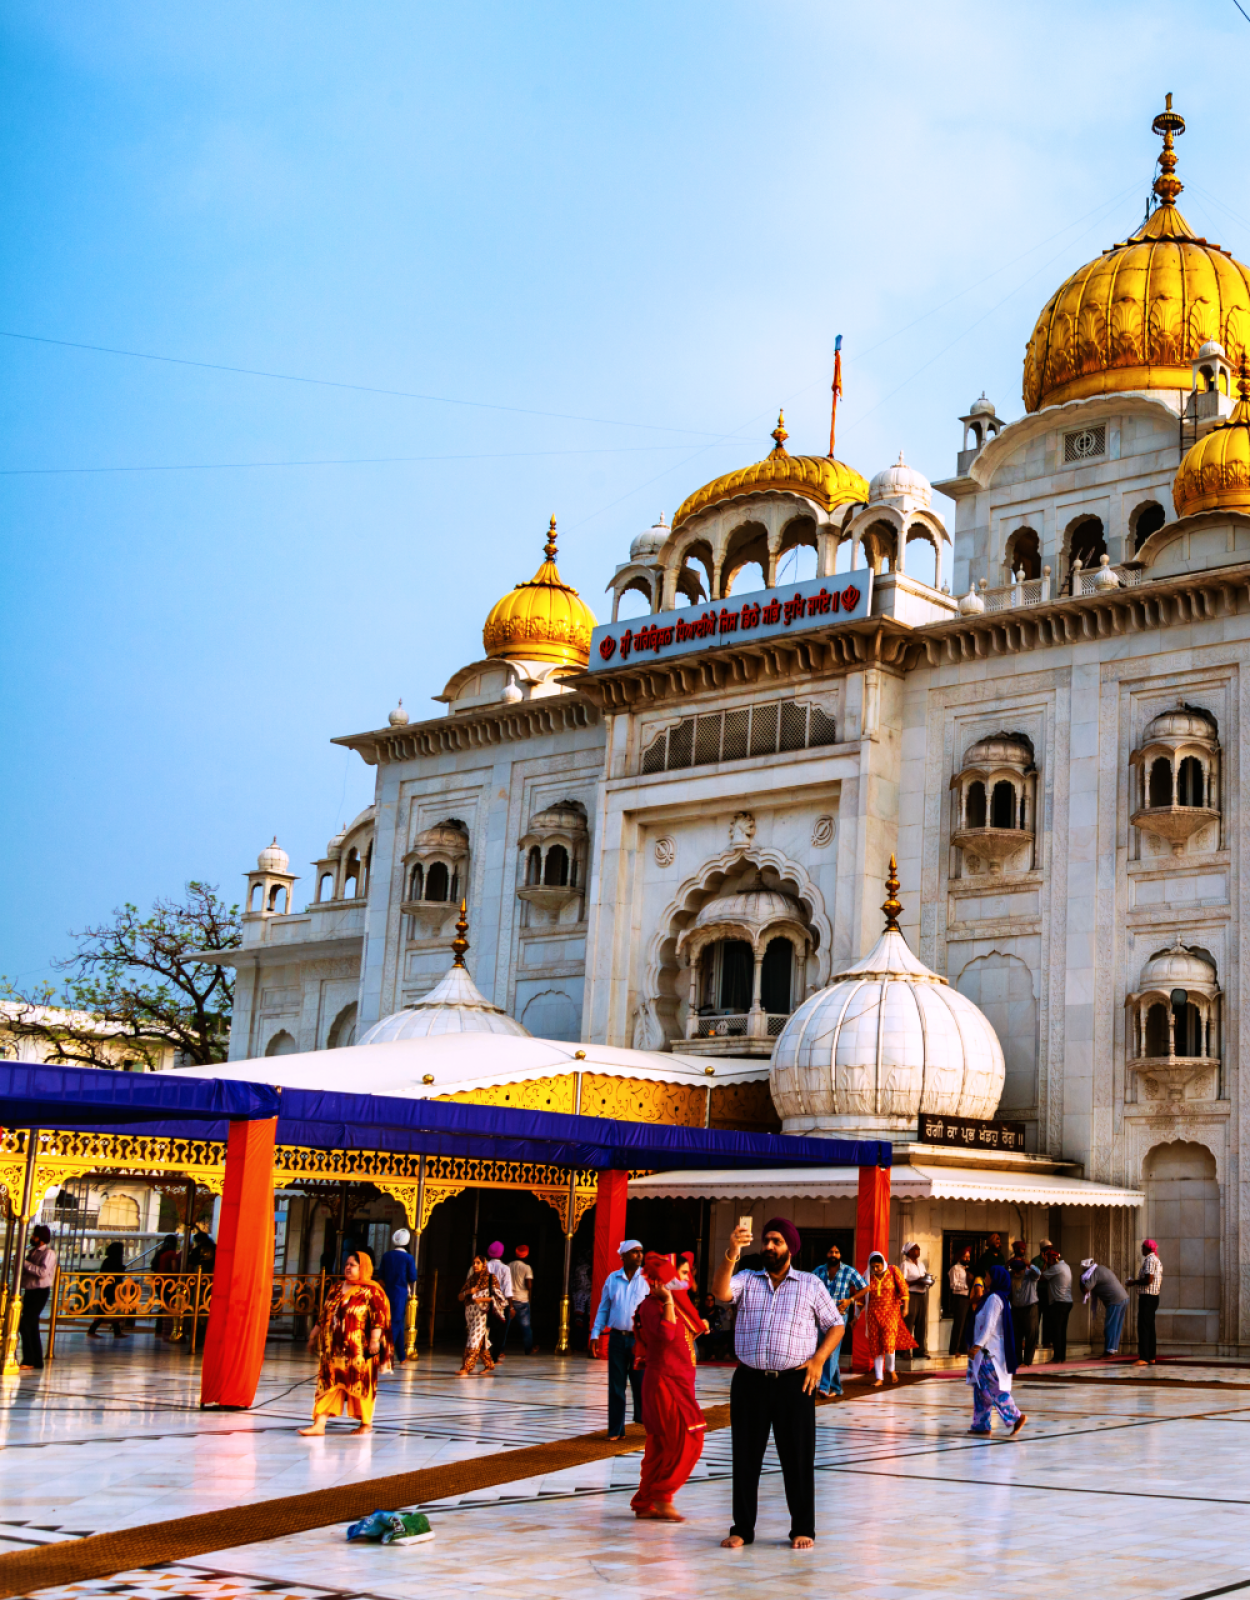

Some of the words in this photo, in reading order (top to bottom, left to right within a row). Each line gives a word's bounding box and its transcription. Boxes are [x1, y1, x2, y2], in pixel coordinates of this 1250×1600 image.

[718, 608, 738, 633] ਜਿਸ
[925, 1119, 944, 1138] ਰੋਗੀ
[947, 1125, 958, 1140] ਕਾ
